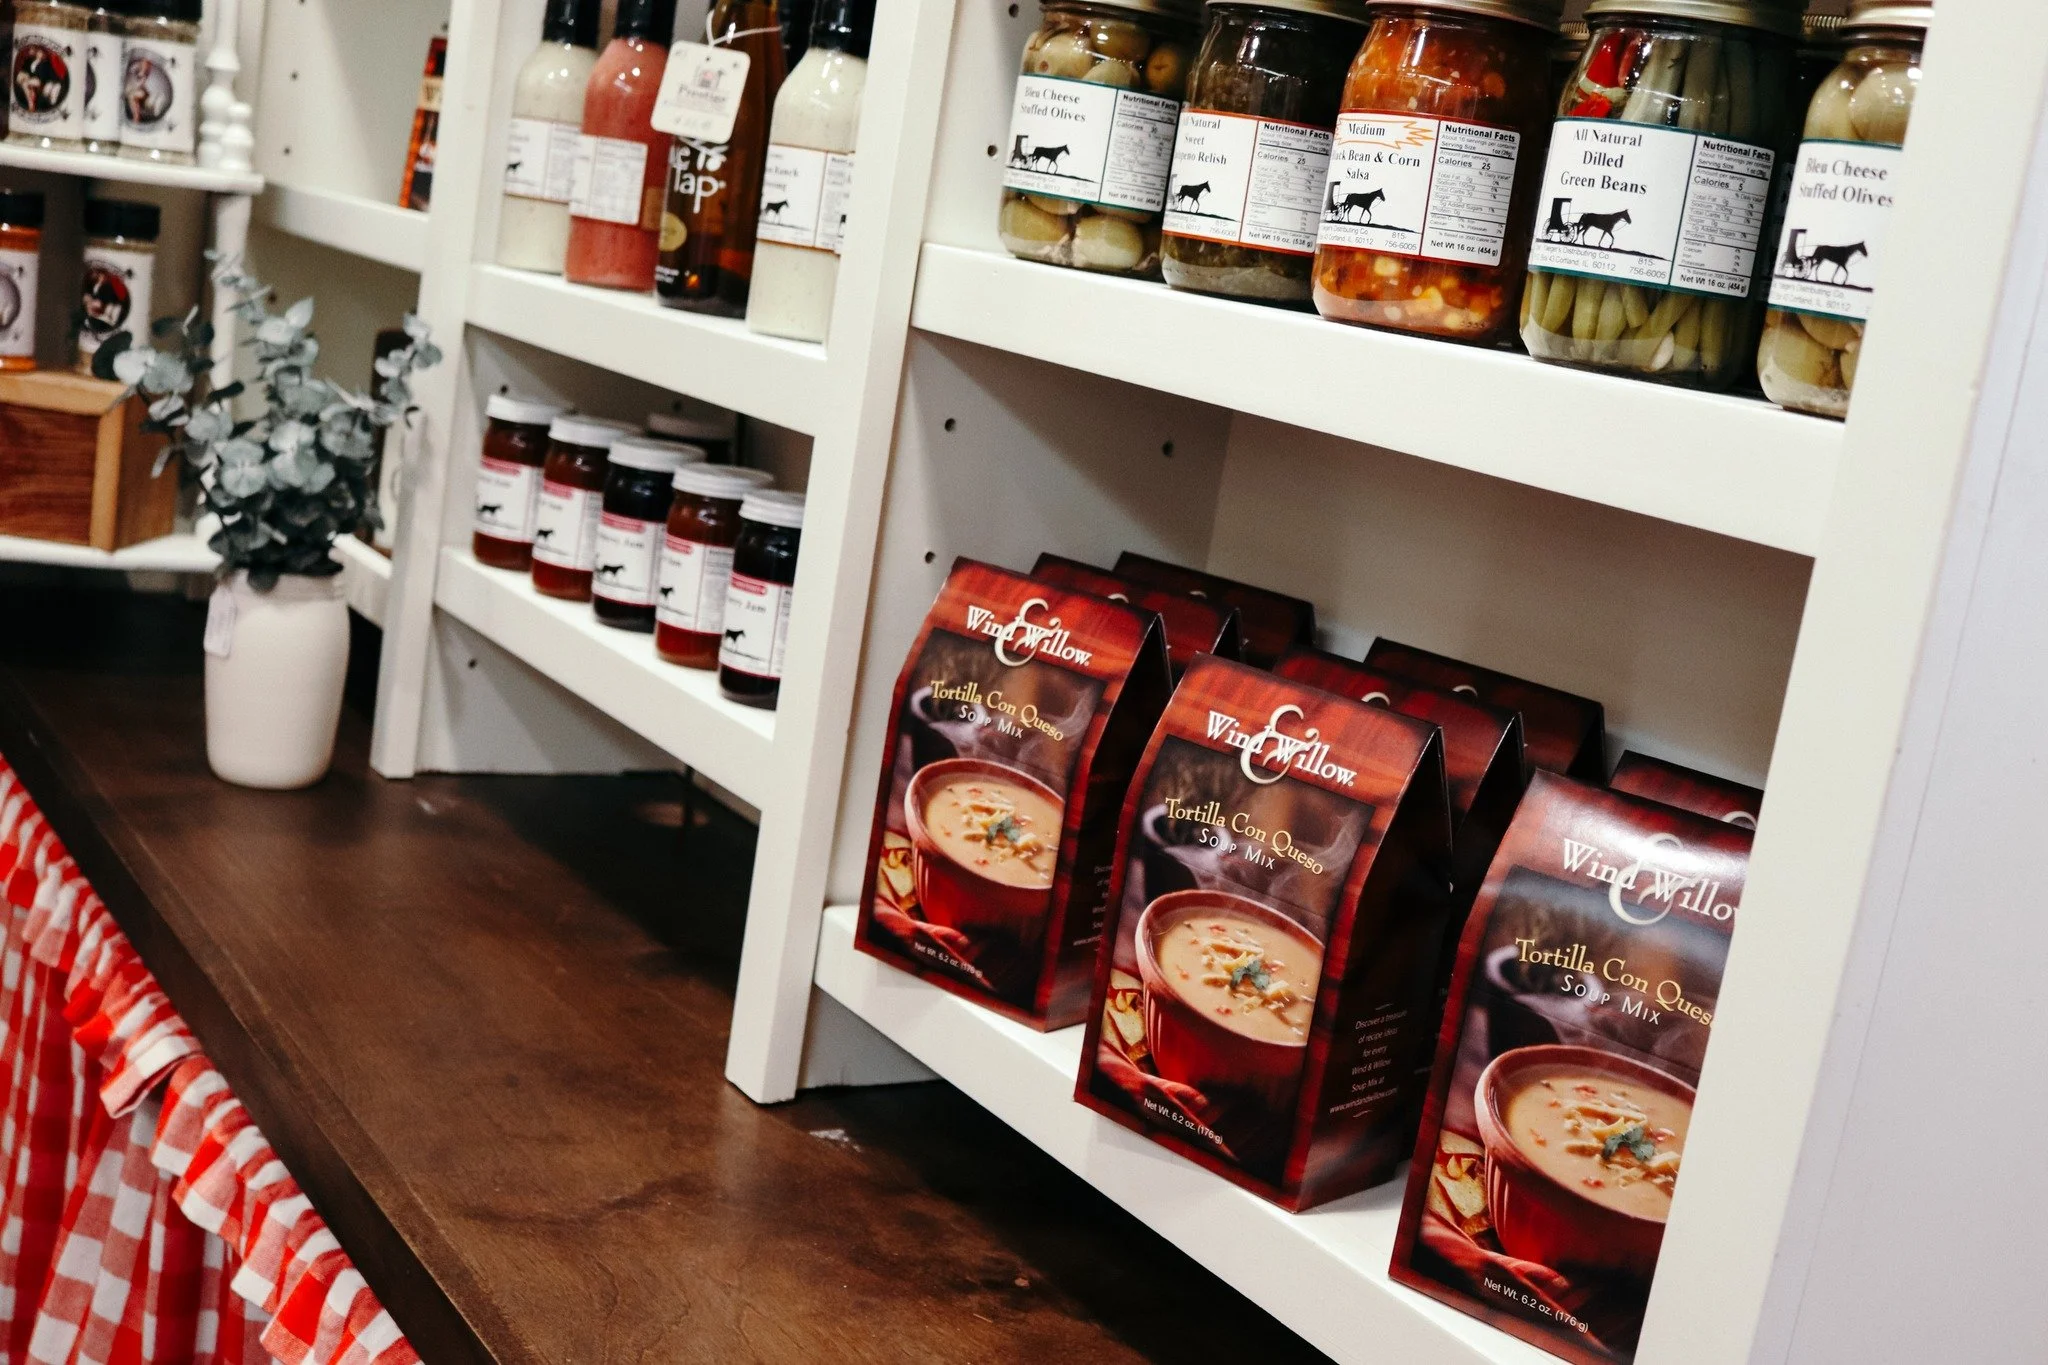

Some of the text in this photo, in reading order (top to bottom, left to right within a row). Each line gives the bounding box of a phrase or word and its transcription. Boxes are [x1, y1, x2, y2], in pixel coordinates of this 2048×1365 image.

[1043, 88, 1080, 104] Cheese
[1051, 106, 1086, 122] Olives
[1116, 121, 1143, 131] Calories
[1191, 116, 1221, 129] Natural
[1348, 123, 1386, 136] Medium
[1264, 123, 1330, 140] Nutritional Facts
[1445, 124, 1516, 142] Nutritional Facts
[1573, 129, 1643, 147] All Natural
[1197, 151, 1227, 165] Relish
[1257, 151, 1288, 162] Calories
[1348, 149, 1371, 162] Bean
[1373, 151, 1384, 163] &
[1388, 152, 1421, 168] Corn
[1702, 140, 1771, 161] Nutritional Facts
[1438, 156, 1491, 171] Calories 25
[1583, 150, 1624, 168] Dilled
[1698, 159, 1721, 168] Serving
[1346, 168, 1370, 181] Salsa
[1806, 157, 1888, 181] Bleu Cheese
[1560, 171, 1648, 195] Green Beans
[1694, 176, 1744, 191] Calories 5
[1798, 181, 1894, 208] Stuffed Olives
[1248, 231, 1260, 239] Net
[1430, 240, 1444, 248] Net
[1457, 243, 1465, 251] 16
[1477, 246, 1491, 254] (454
[1491, 249, 1499, 257] g)
[1562, 247, 1597, 259] Distributing
[1592, 259, 1616, 271] 60112
[1637, 257, 1655, 266] 815-
[1629, 266, 1667, 279] 756-6005
[1680, 274, 1694, 283] Net
[1695, 277, 1706, 285] Wt
[966, 605, 1022, 641] Wind
[995, 598, 1061, 667] &
[930, 680, 1064, 742] Tortilla Con Queso
[1206, 710, 1272, 755] Wind
[1240, 704, 1320, 784] &
[1165, 797, 1324, 875] Tortilla Con Queso
[1563, 838, 1642, 891] Wind
[1653, 867, 1740, 921] Willo
[1515, 937, 1714, 1026] Tortilla Con Ques
[1351, 1065, 1367, 1075] Wind
[1351, 1082, 1367, 1093] Soup
[1368, 1078, 1377, 1087] Mix
[1144, 1097, 1223, 1145] Net Wt. 6.2 oz. (176 g)
[1484, 1277, 1589, 1334] Net Wt. 6.2 oz. (176 g)
